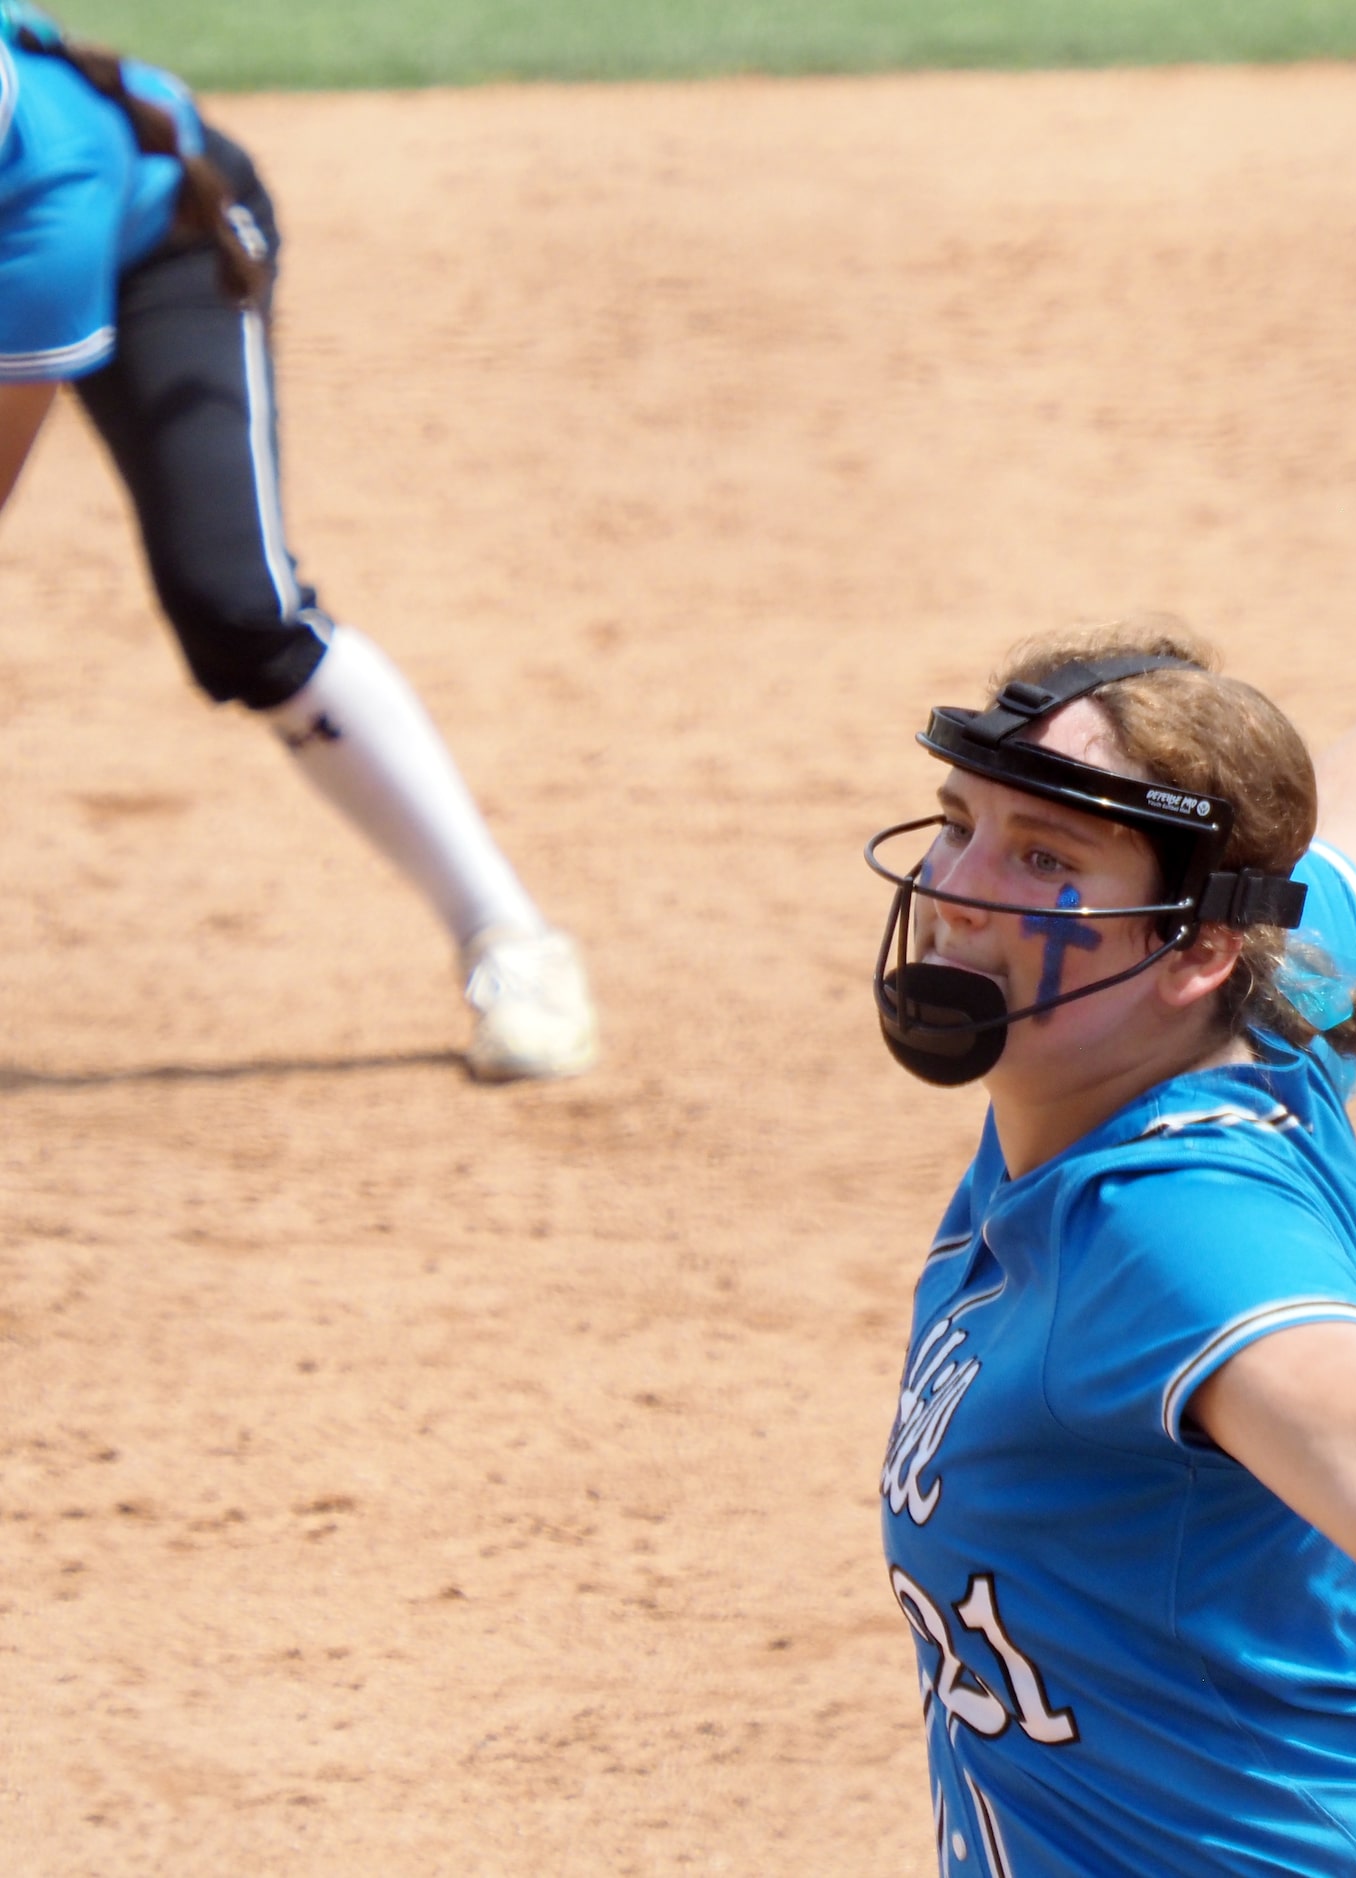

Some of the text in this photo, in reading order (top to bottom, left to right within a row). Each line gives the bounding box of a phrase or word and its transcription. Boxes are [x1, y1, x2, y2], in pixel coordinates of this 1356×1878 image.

[1146, 789, 1183, 806] DEFENSE
[1181, 796, 1198, 814] PRO
[888, 1564, 1081, 1745] 21
